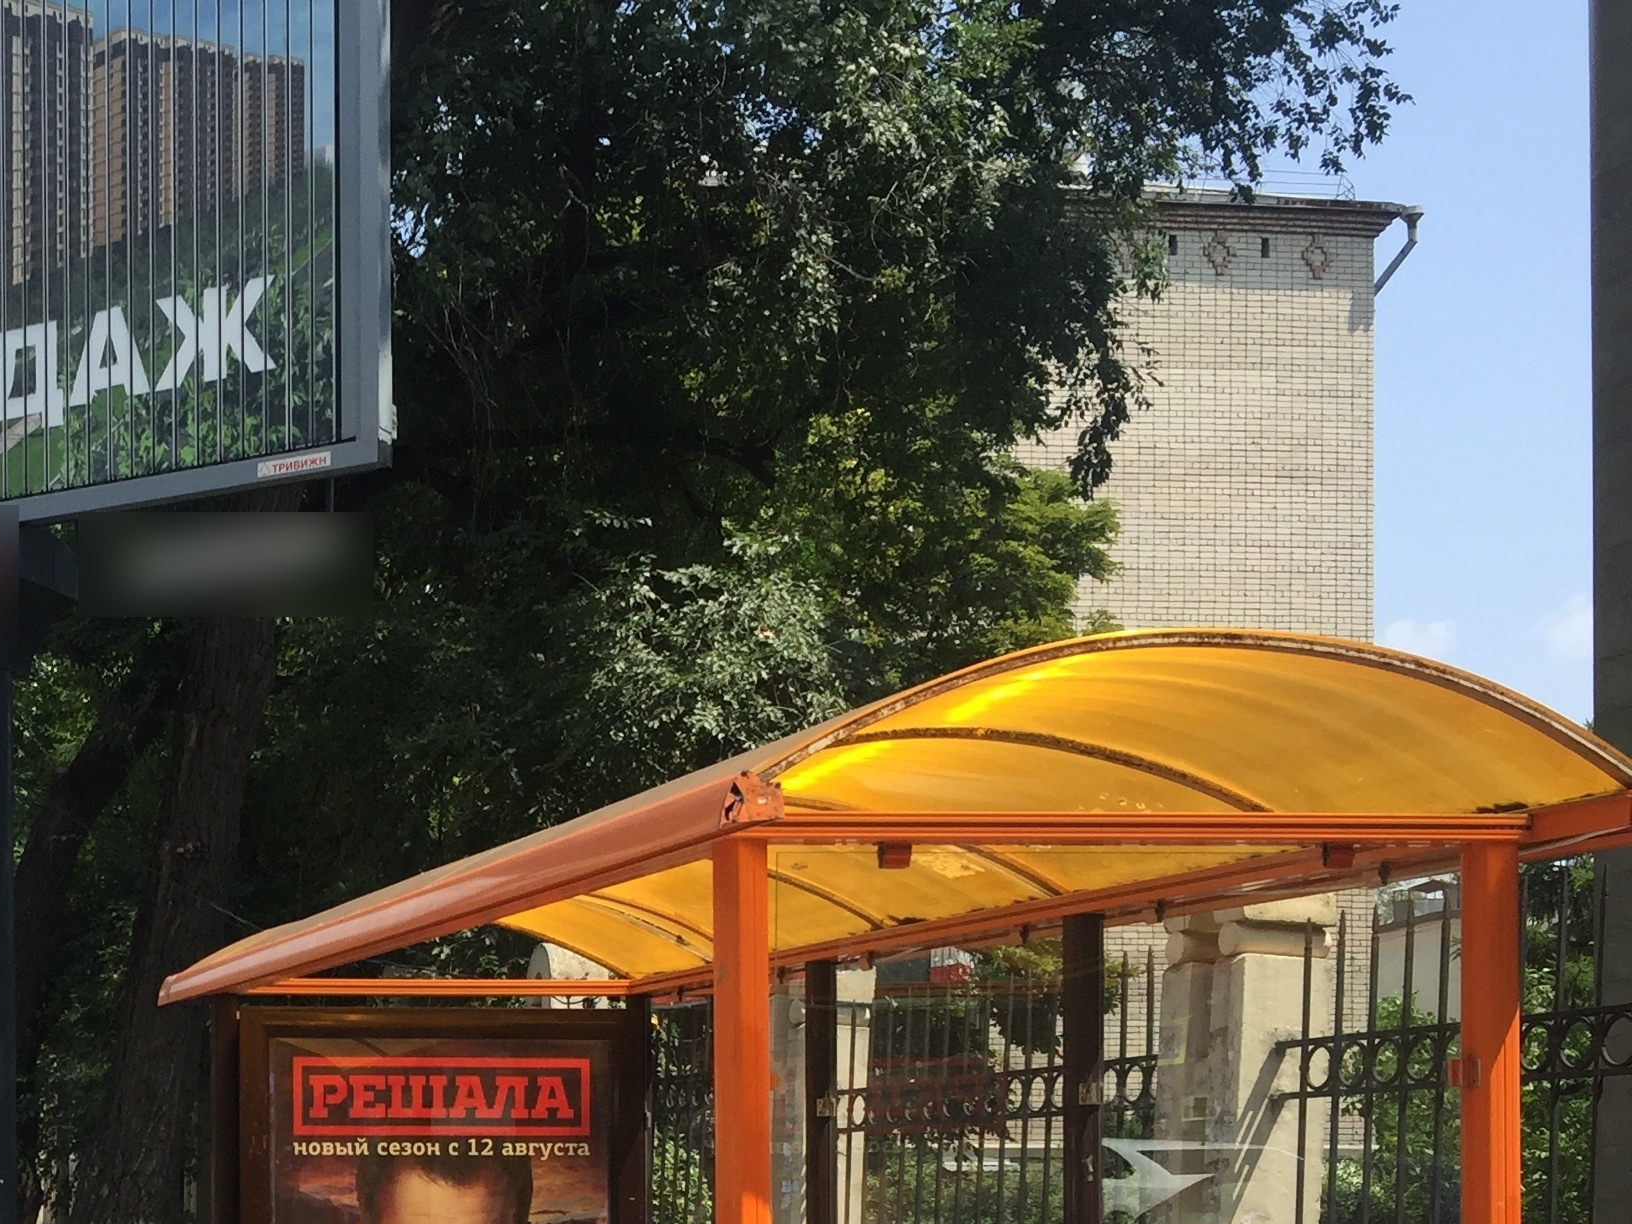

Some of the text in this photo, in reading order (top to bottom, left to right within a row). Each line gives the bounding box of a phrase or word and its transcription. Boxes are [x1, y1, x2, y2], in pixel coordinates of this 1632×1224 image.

[271, 456, 327, 474] ТРИВИЖН
[308, 1074, 575, 1119] РЕШАЛА
[293, 1137, 590, 1161] новый сезон с 12 августа
